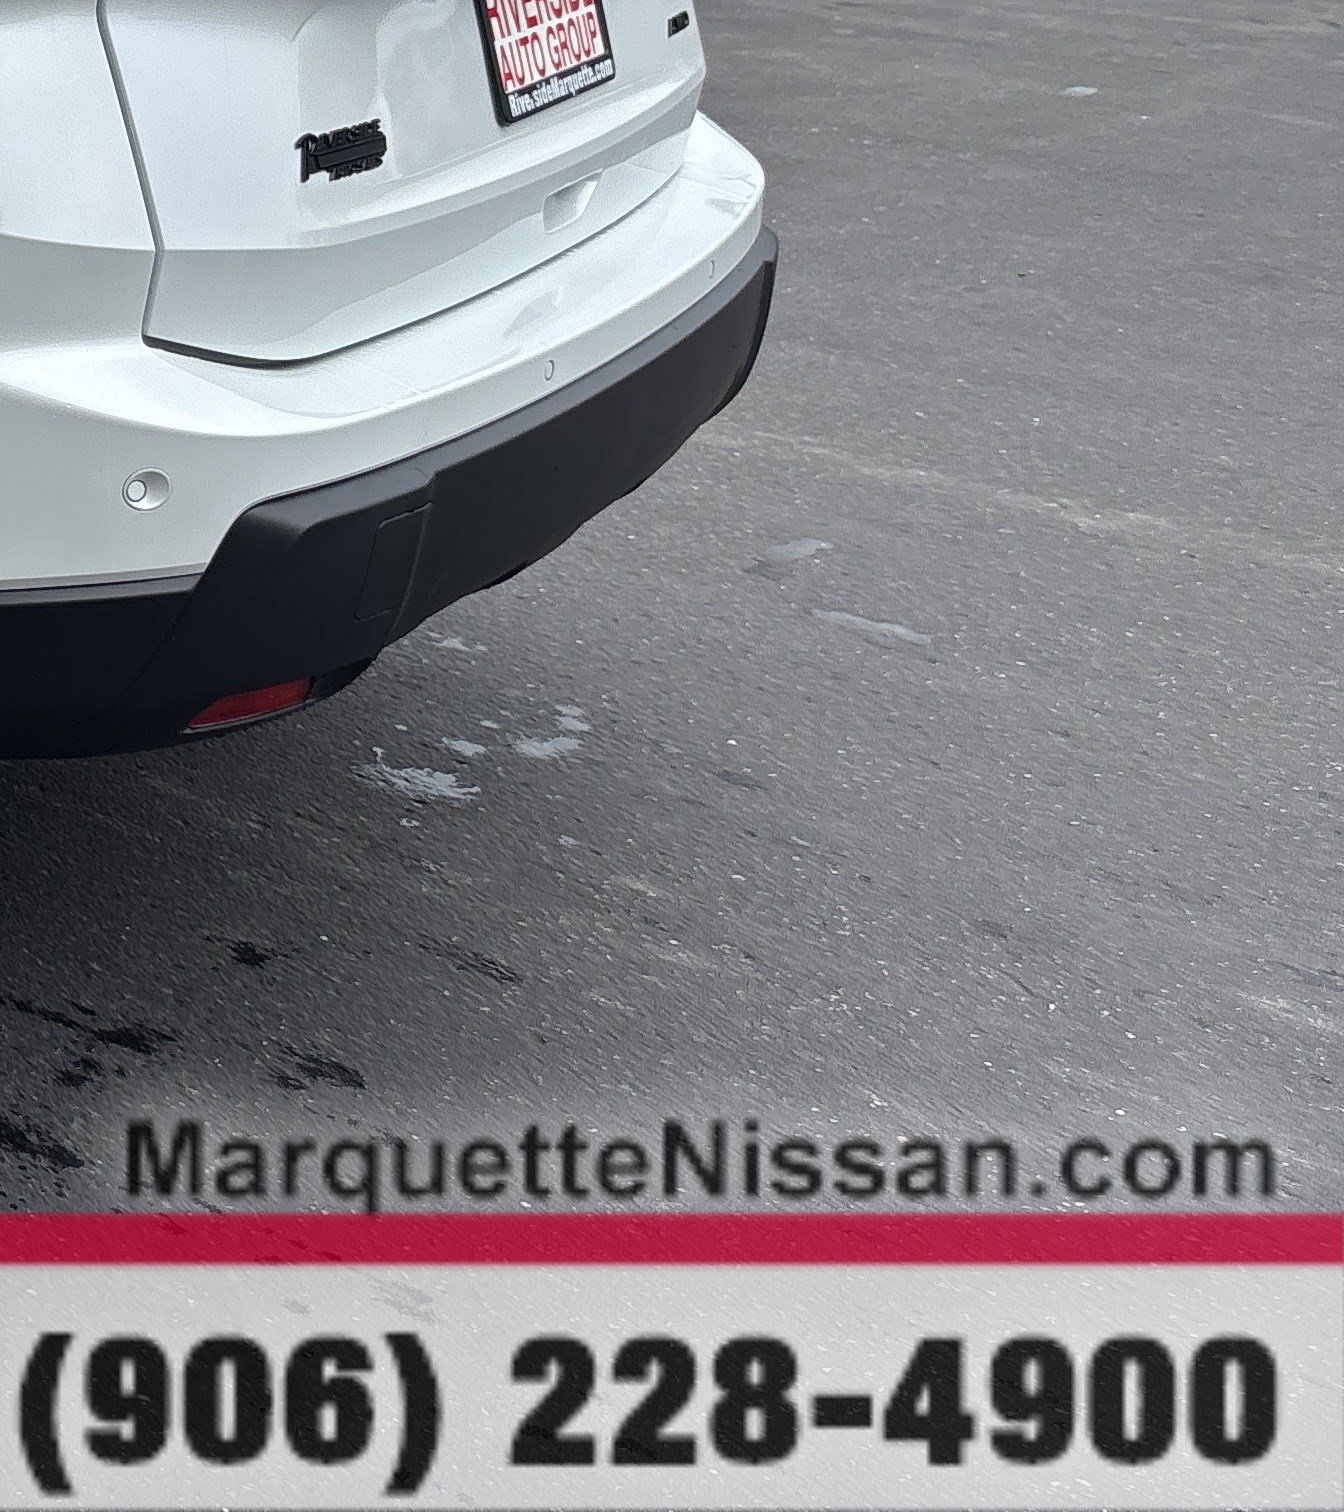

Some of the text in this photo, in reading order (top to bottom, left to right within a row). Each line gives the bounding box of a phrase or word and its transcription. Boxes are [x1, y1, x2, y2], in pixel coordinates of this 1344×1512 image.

[499, 10, 598, 91] AUTO GROUP
[508, 58, 613, 118] RiversideMarquette.com
